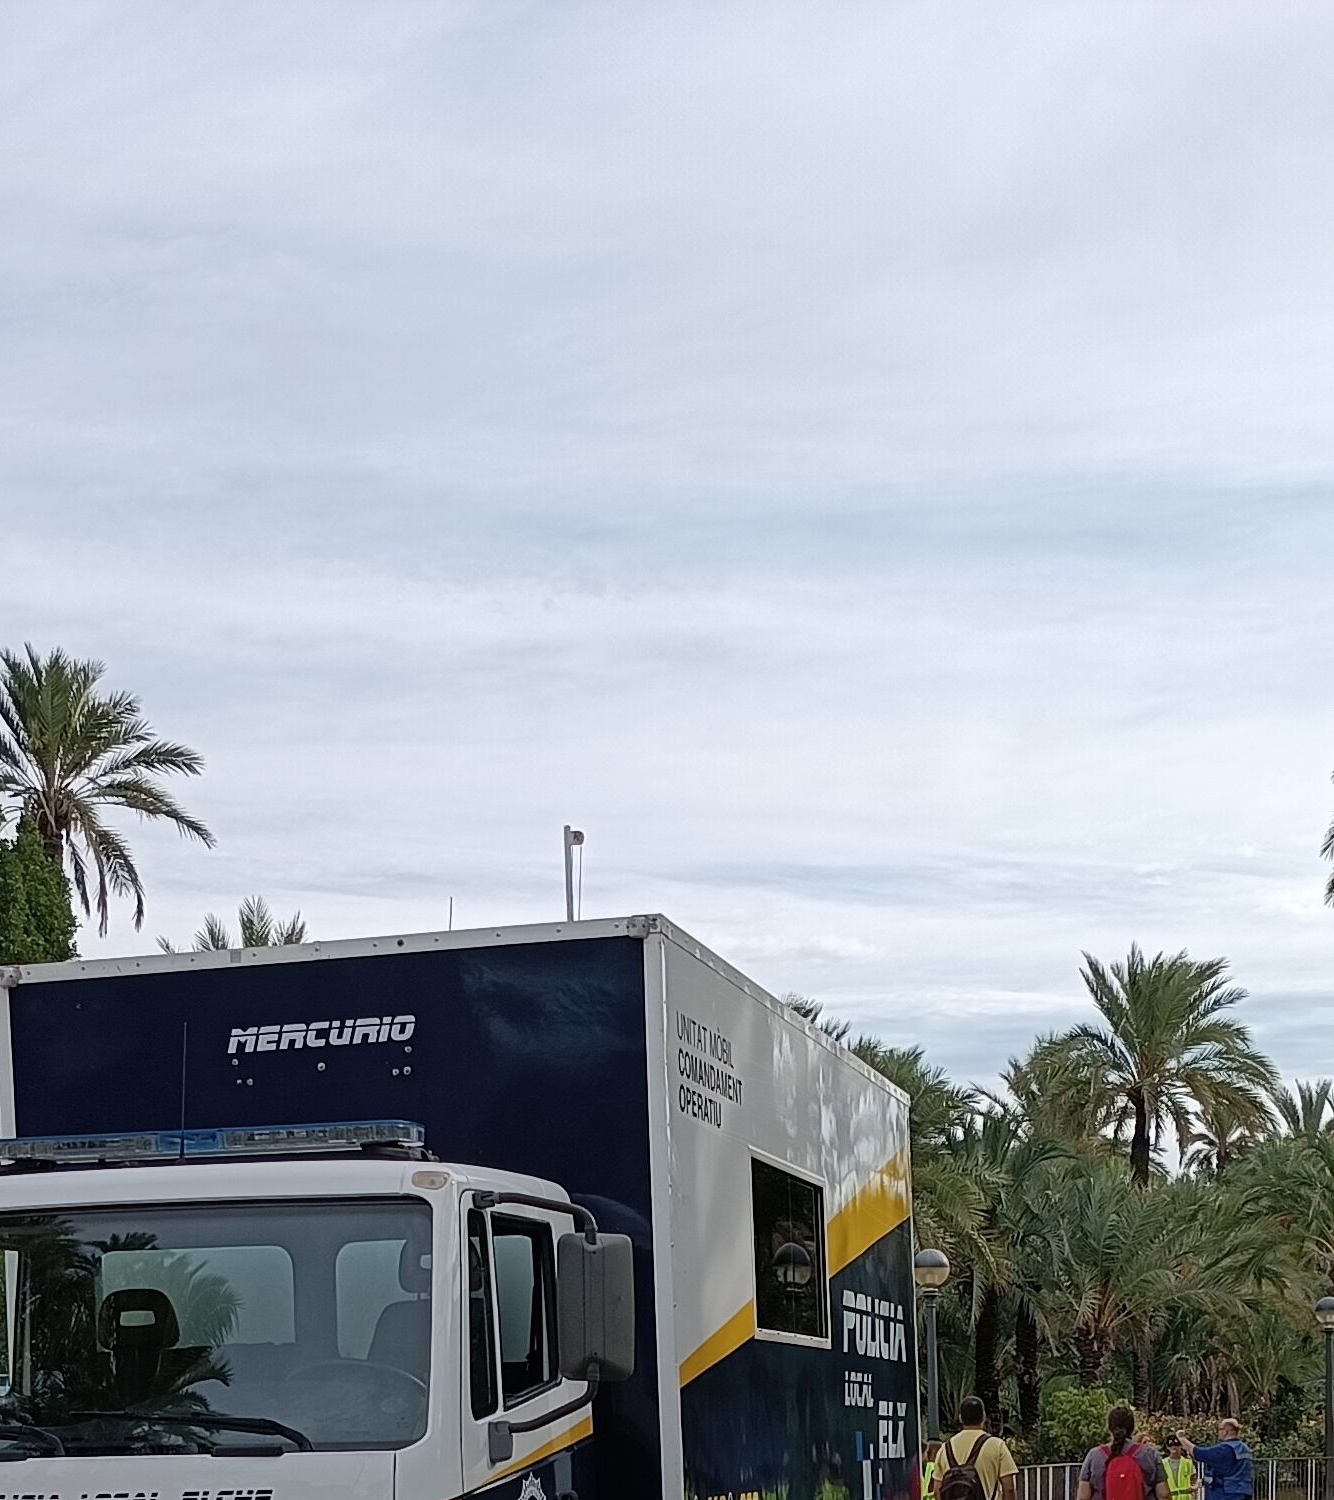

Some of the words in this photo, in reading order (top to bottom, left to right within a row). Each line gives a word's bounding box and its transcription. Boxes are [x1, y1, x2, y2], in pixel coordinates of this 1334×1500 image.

[227, 1014, 416, 1054] MERCURIO
[676, 1009, 707, 1053] UNITAT
[678, 1048, 743, 1106] COMANDAMENT
[679, 1084, 722, 1128] OPERATIU
[842, 1289, 907, 1363] POLICIA
[844, 1370, 874, 1408] LOCAL
[878, 1400, 907, 1459] ELX
